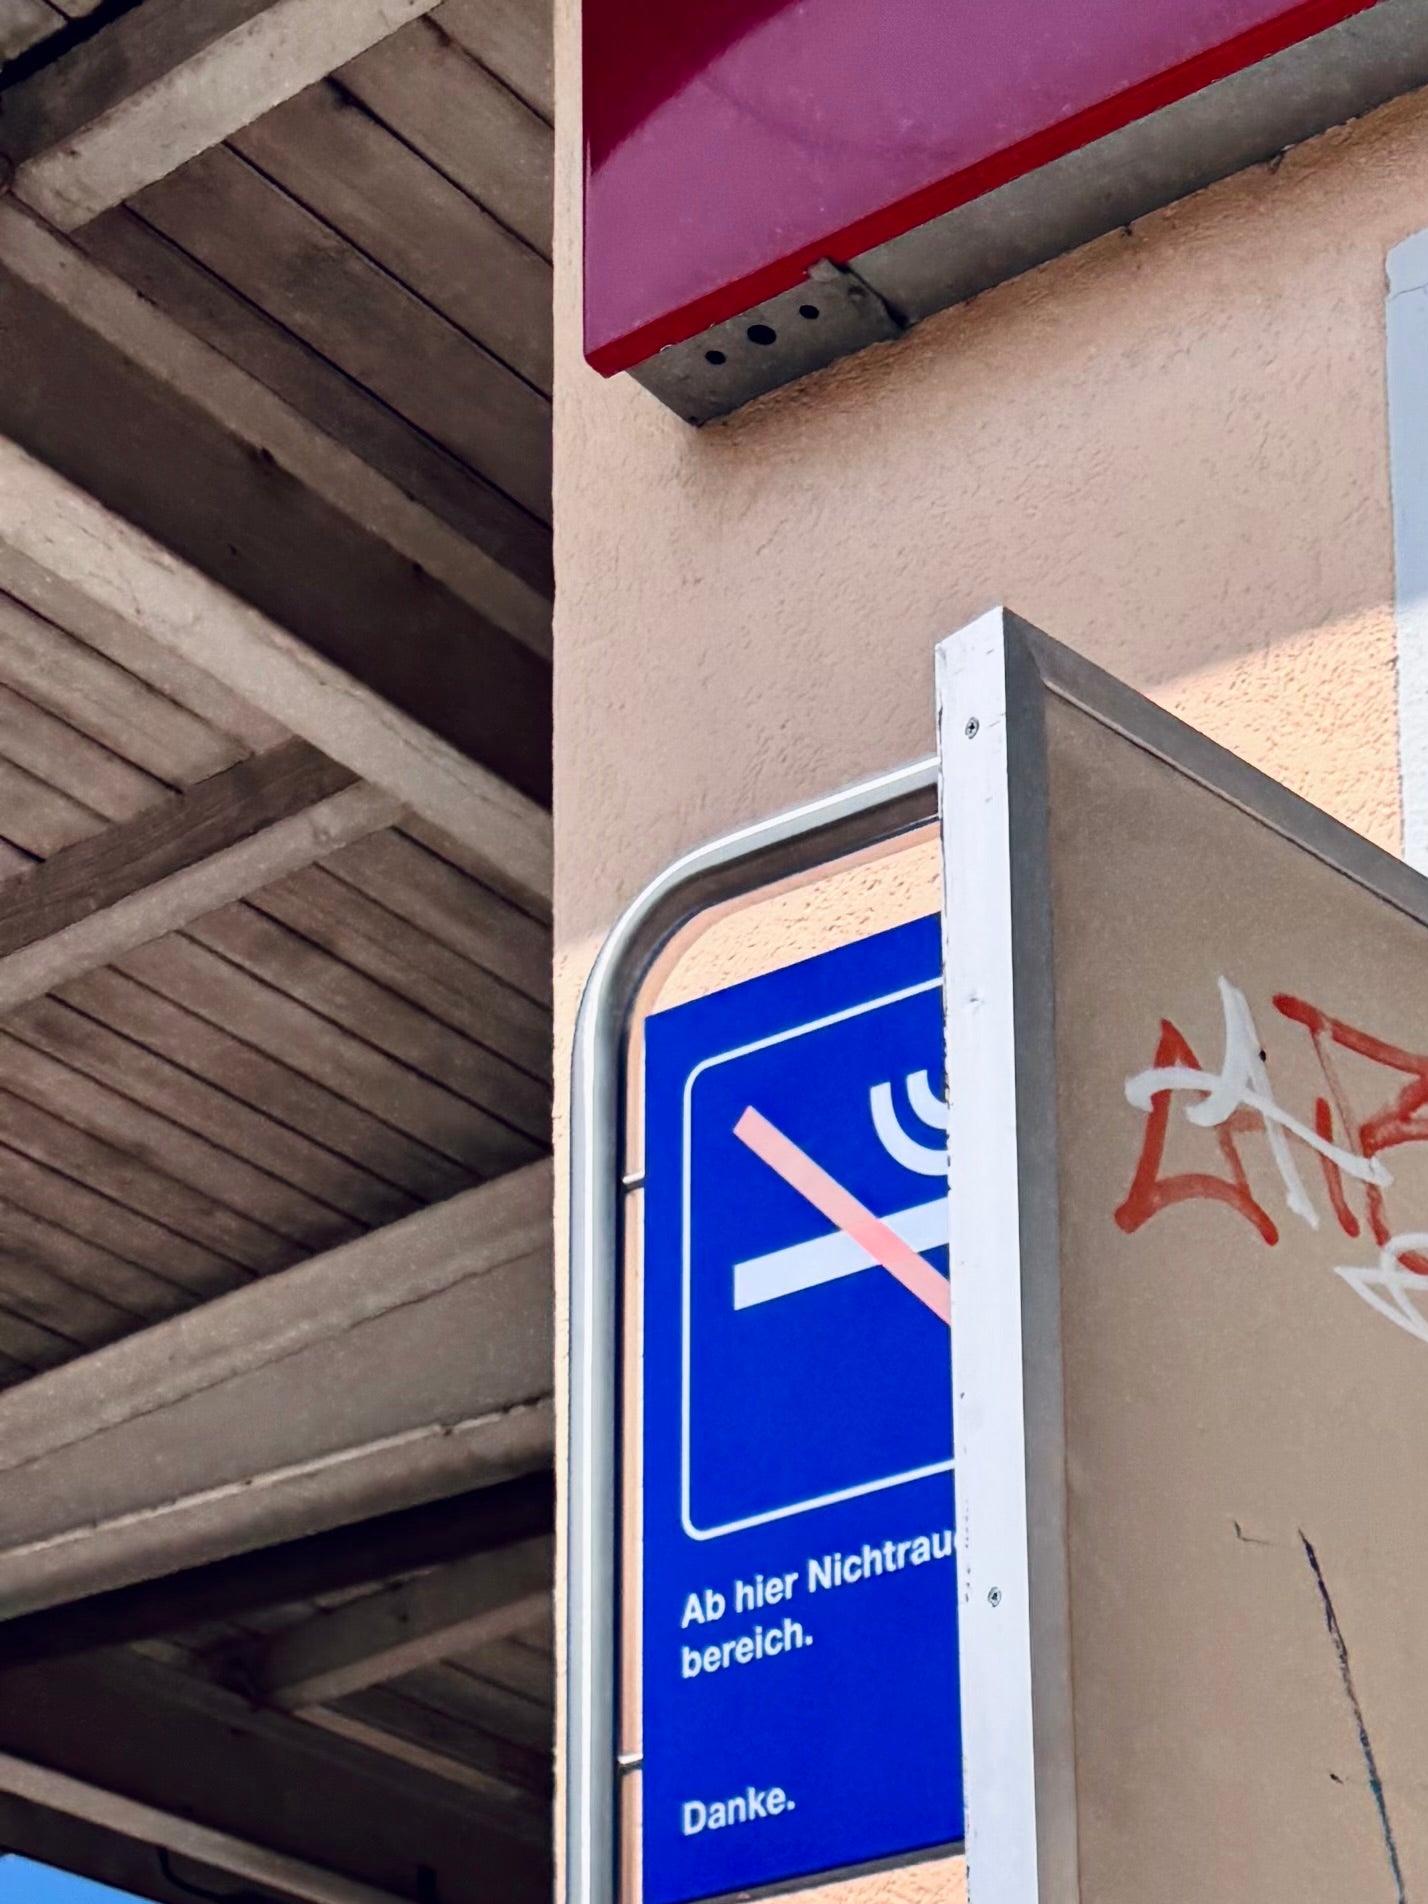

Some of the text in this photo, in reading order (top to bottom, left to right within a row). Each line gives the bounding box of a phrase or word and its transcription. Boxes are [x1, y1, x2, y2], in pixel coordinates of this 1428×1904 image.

[681, 1530, 957, 1629] Ab hier Nichtrau
[681, 1618, 814, 1679] bereich.
[682, 1787, 796, 1836] Danke.
